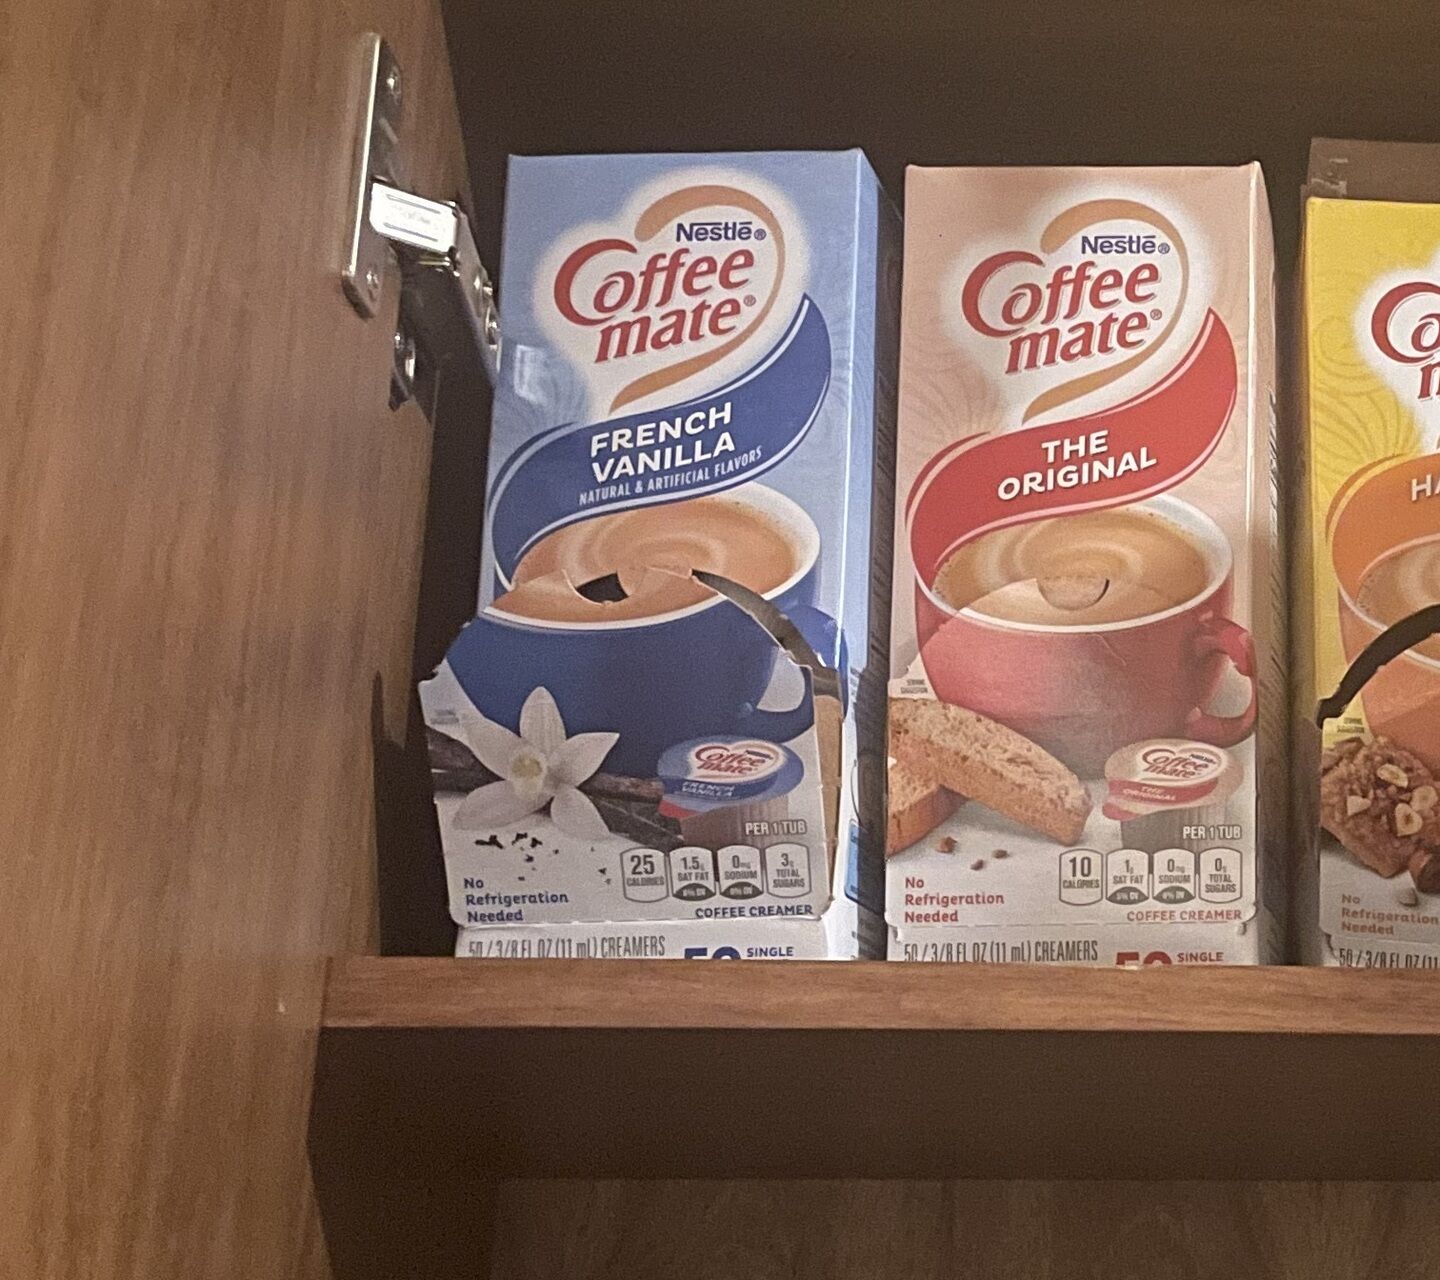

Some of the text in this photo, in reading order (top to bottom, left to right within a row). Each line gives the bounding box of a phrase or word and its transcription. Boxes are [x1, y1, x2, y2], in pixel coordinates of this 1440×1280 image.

[553, 238, 754, 326] Coffee
[962, 251, 1160, 337] Coffee
[590, 402, 732, 457] FRENCH
[1042, 430, 1108, 464] THE
[592, 431, 736, 483] VANILLA
[579, 446, 762, 505] NATURAL & ARTIFICIAL FLAVORS
[997, 447, 1157, 501] ORIGINAL
[745, 820, 807, 836] PER 1 TUB
[1183, 825, 1241, 840] PER 1 TUB
[630, 854, 655, 875] 25
[1069, 856, 1091, 877] 10
[464, 878, 484, 889] No
[695, 871, 709, 881] FAT
[905, 877, 924, 889] No
[1130, 875, 1144, 884] FAT
[1209, 874, 1232, 883] TOTAL
[1205, 884, 1236, 893] SUGARS
[466, 891, 569, 907] Refrigeration
[905, 892, 1004, 907] Refrigeration
[1341, 894, 1360, 905] No
[467, 909, 523, 923] Needed
[695, 904, 813, 918] COFFEE CREAMER
[904, 910, 958, 923] Needed
[1127, 909, 1242, 921] COFFEE CREAMER
[1341, 907, 1439, 925] Refrigeration
[1341, 922, 1394, 935] Needed
[601, 935, 665, 957] CREAMERS
[746, 947, 794, 957] SINGLE
[972, 942, 987, 963] OZ
[1035, 939, 1098, 962] CREAMERS
[1177, 952, 1224, 962] SINGLE
